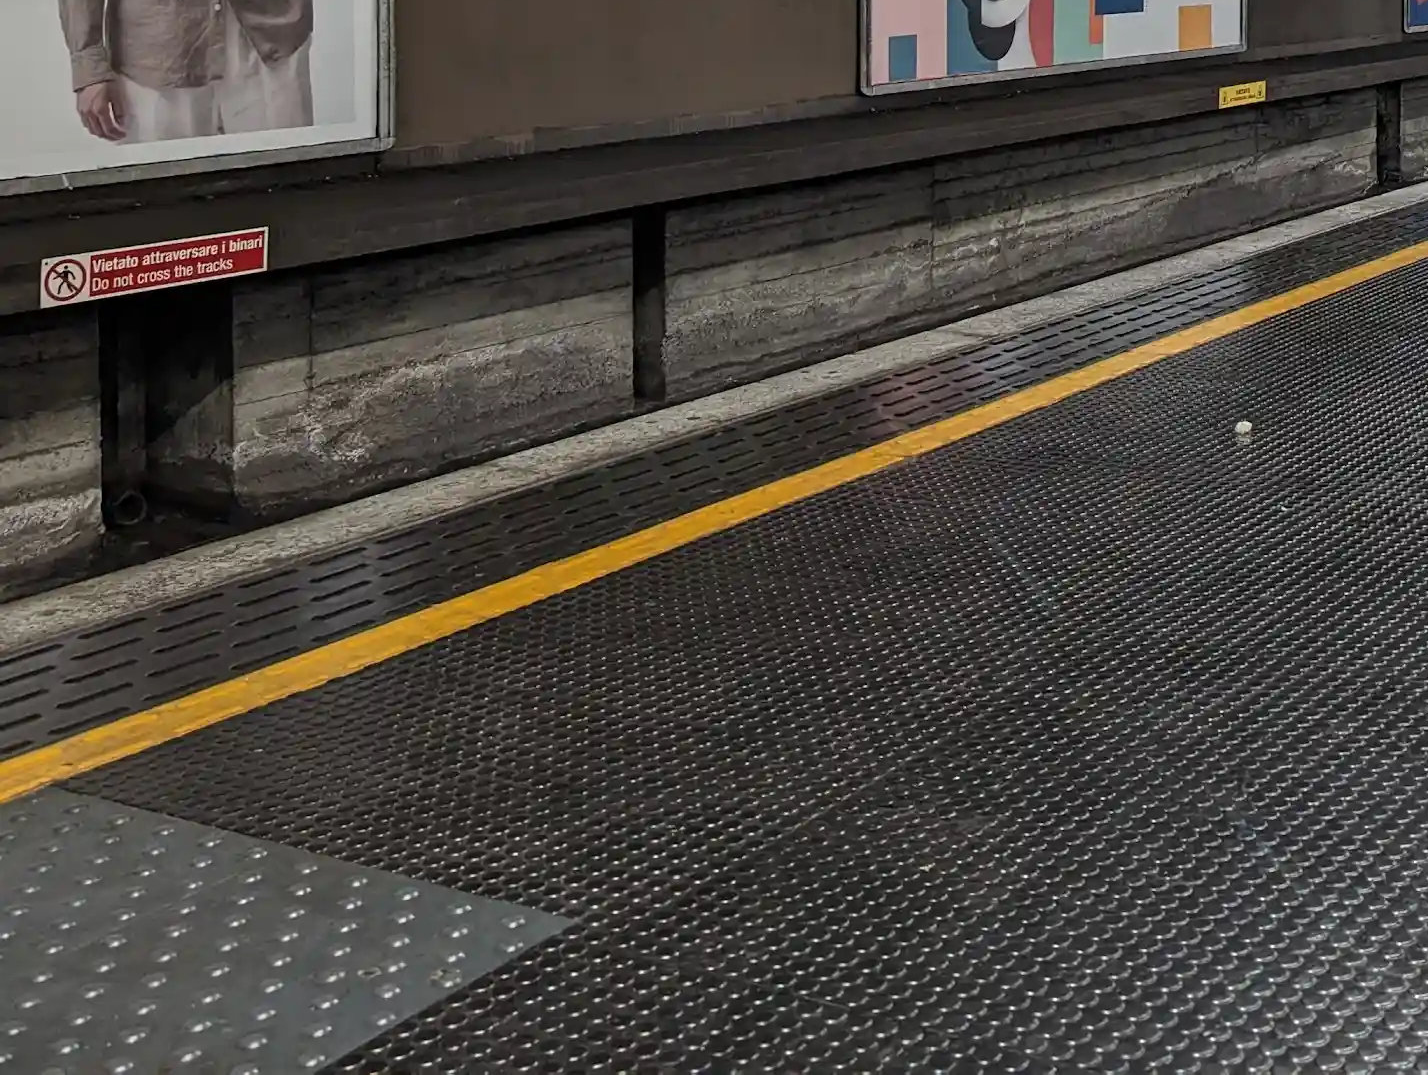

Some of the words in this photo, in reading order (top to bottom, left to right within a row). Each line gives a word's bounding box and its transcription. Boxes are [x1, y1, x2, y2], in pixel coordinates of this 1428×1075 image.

[92, 254, 138, 274] Vietato
[141, 244, 218, 266] attraversare
[222, 240, 226, 254] i
[229, 235, 263, 253] binari
[92, 277, 110, 292] Do
[113, 271, 134, 288] not
[137, 266, 171, 285] cross
[174, 263, 193, 279] the
[197, 257, 233, 276] tracks
